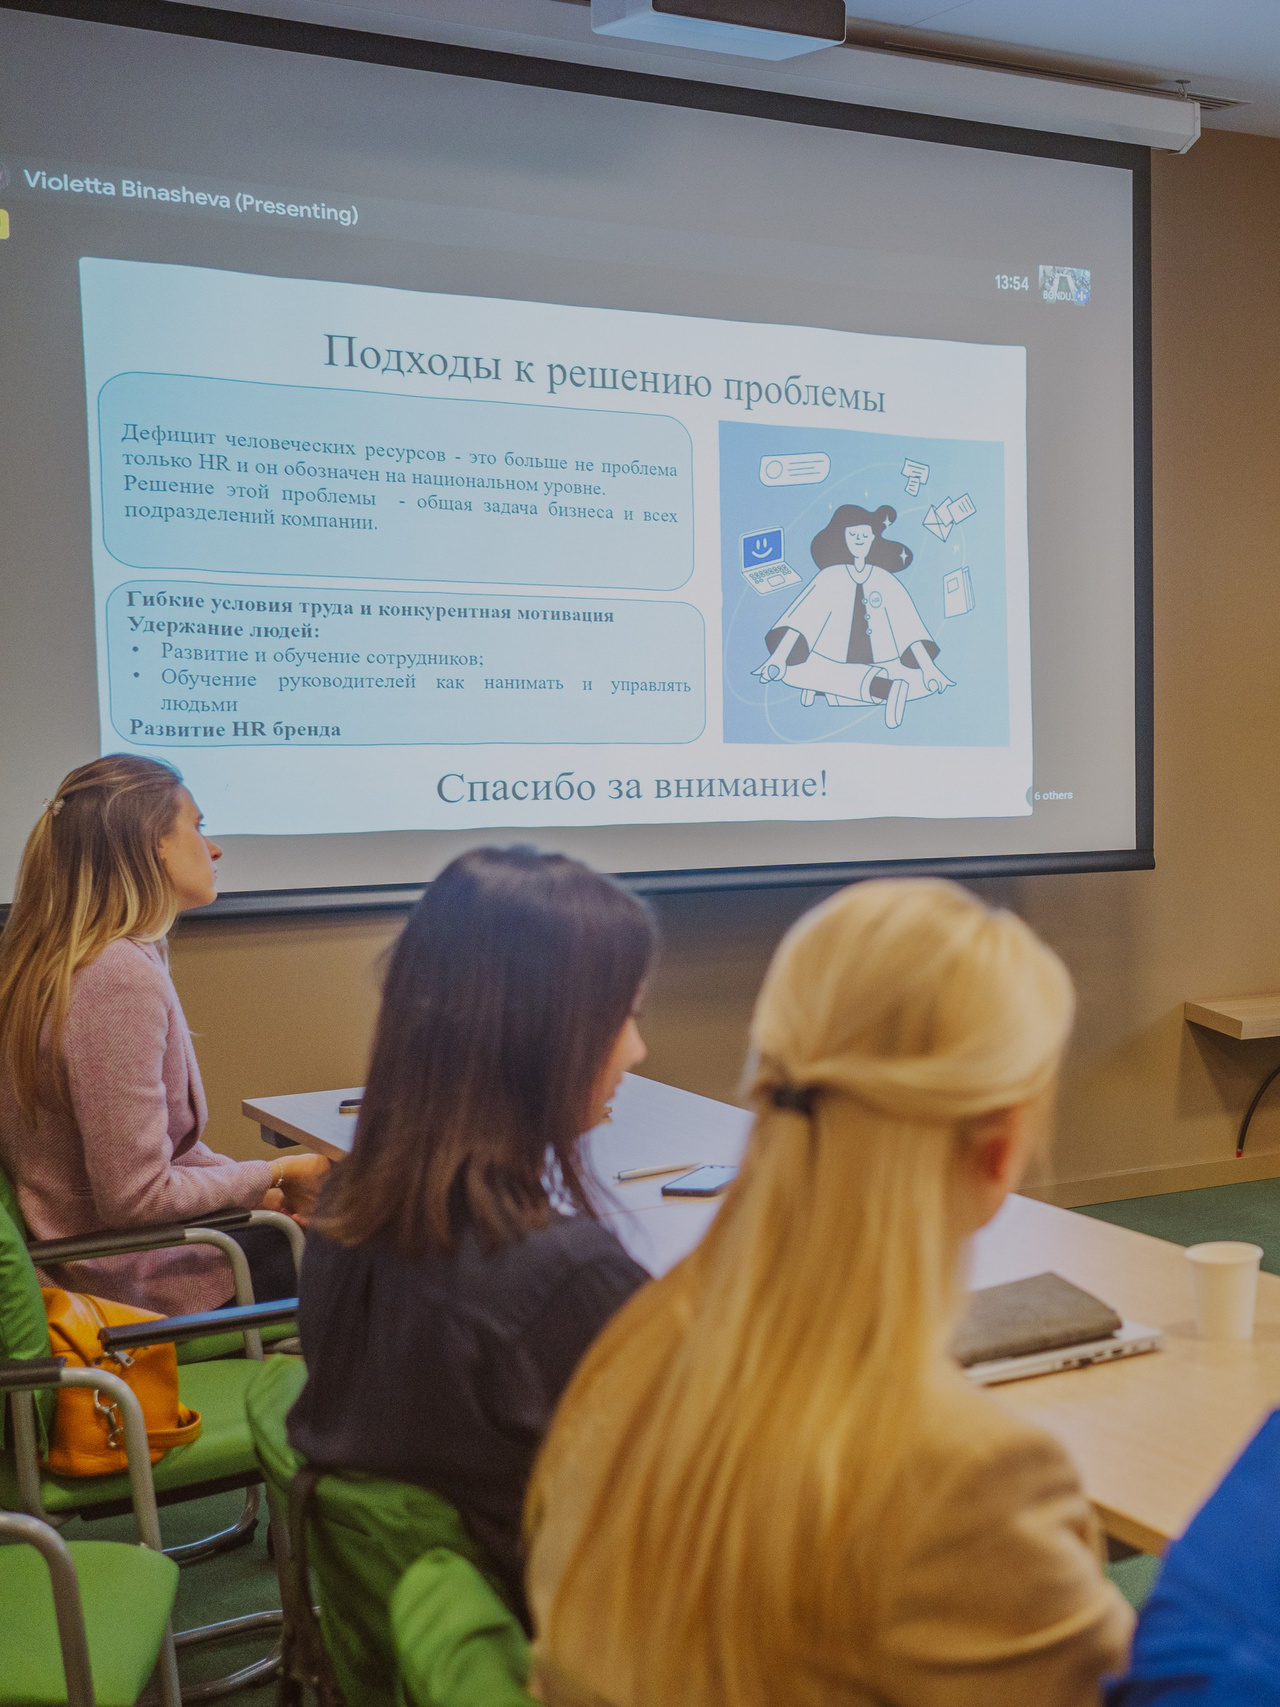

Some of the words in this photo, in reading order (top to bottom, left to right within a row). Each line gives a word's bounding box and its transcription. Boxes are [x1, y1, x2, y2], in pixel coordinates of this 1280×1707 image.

[23, 169, 116, 196] Violetta
[121, 179, 231, 209] Binasheva
[235, 192, 359, 226] (Presenting)
[995, 274, 1029, 291] 13:54
[323, 333, 502, 384] Подходы
[514, 359, 535, 383] к
[546, 362, 712, 398] решению
[723, 374, 887, 413] проблемы
[121, 423, 216, 445] Дефицит
[226, 434, 356, 456] человеческих
[365, 444, 446, 463] ресурсов
[469, 453, 497, 465] это
[504, 451, 568, 471] больше
[575, 459, 595, 472] не
[601, 460, 678, 478] проблема
[122, 453, 192, 469] только
[198, 453, 231, 472] HR
[237, 460, 249, 473] и
[254, 461, 278, 475] он
[284, 461, 380, 483] обозначен
[385, 471, 407, 484] на
[412, 472, 539, 492] национальном
[543, 480, 606, 497] уровне.
[123, 475, 215, 495] Решение
[226, 483, 270, 500] этой
[281, 487, 377, 507] проблемы
[416, 494, 473, 513] общая
[483, 501, 538, 517] задача
[548, 502, 614, 519] бизнеса
[623, 509, 634, 521] и
[643, 510, 679, 523] всех
[124, 504, 276, 526] подразделений
[281, 513, 378, 531] компании.
[126, 590, 205, 609] Гибкие
[211, 597, 293, 614] условия
[299, 602, 354, 618] труда
[360, 604, 372, 616] и
[378, 604, 511, 622] конкурентная
[517, 609, 615, 623] мотивация
[127, 616, 244, 638] Удержание
[249, 623, 320, 640] людей:
[161, 642, 249, 663] Развитие
[255, 651, 267, 663] и
[273, 647, 361, 667] обучение
[366, 651, 484, 670] сотрудников;
[161, 668, 258, 690] Обучение
[278, 672, 416, 692] руководителей
[435, 677, 465, 690] как
[484, 677, 564, 691] нанимать
[582, 679, 593, 692] и
[611, 679, 692, 696] управлять
[160, 698, 239, 714] людьми
[129, 718, 226, 738] Развитие
[231, 720, 267, 738] HR
[272, 721, 341, 741] бренда
[436, 771, 597, 805] Спасибо
[607, 778, 644, 800] за
[653, 769, 829, 800] внимание!
[1042, 790, 1074, 800] others
